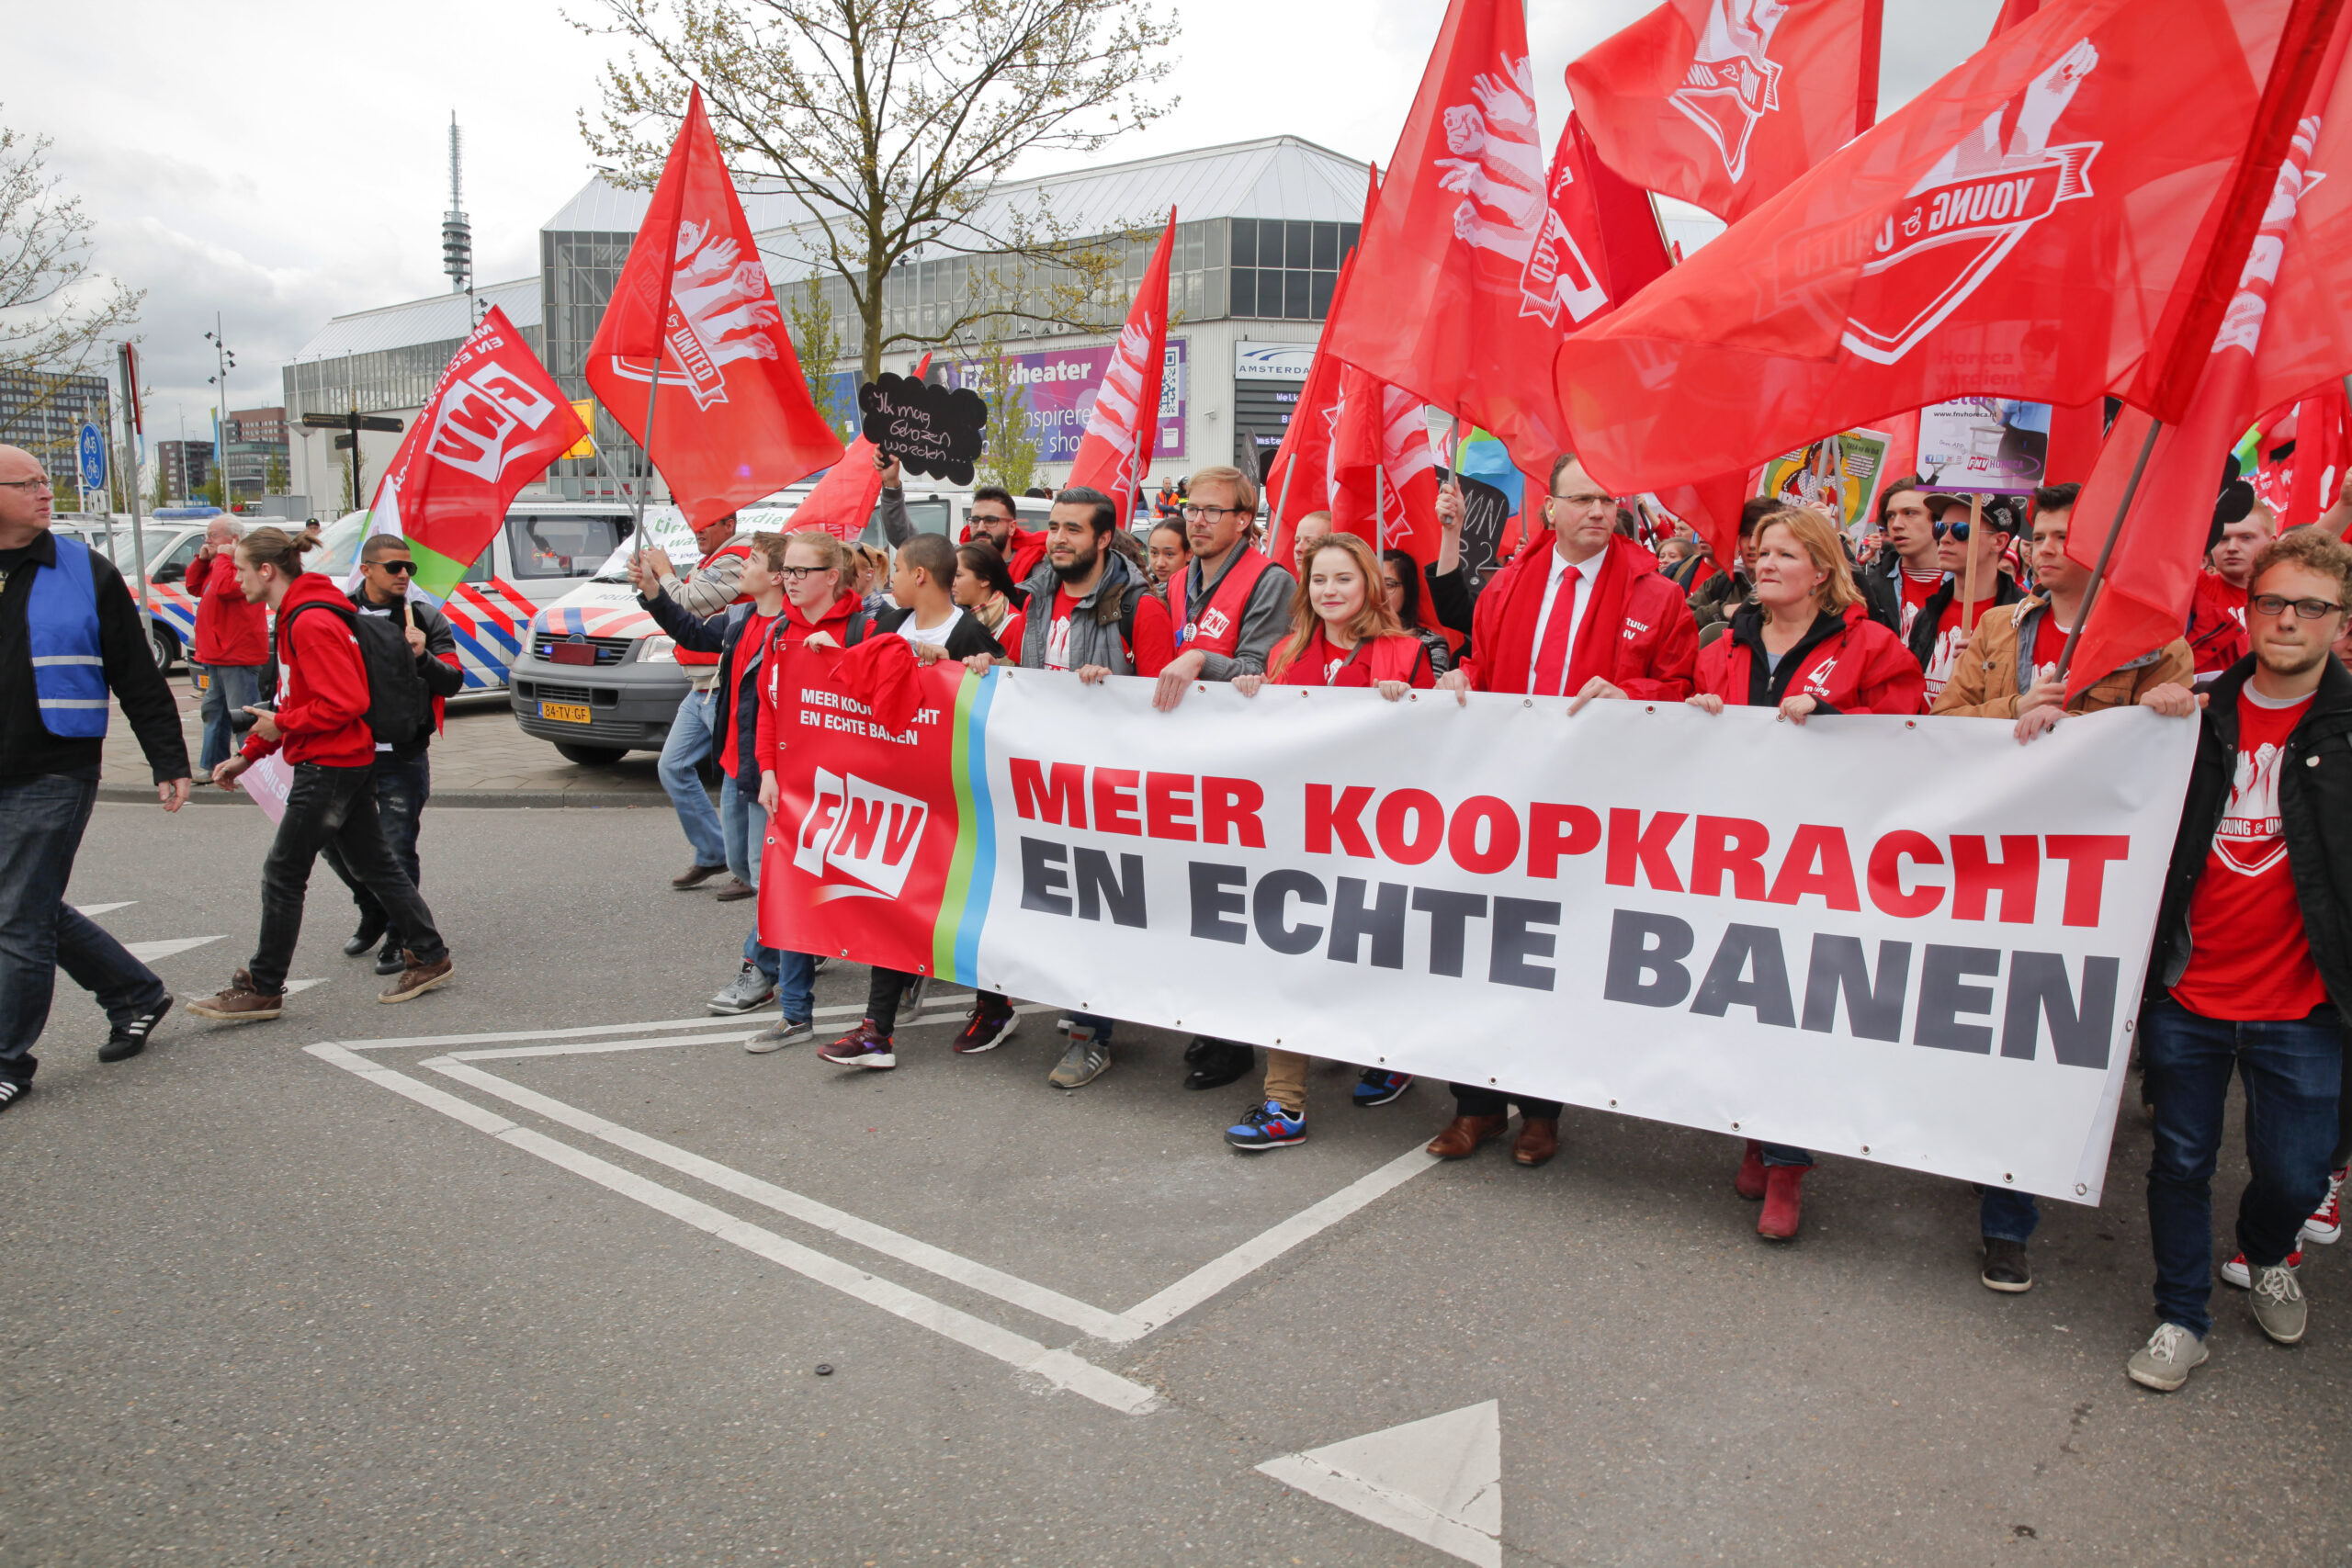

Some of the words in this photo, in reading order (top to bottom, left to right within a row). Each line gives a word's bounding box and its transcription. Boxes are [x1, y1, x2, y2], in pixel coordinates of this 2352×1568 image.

[673, 327, 715, 382] UNITED
[1009, 358, 1092, 385] theater
[1238, 365, 1310, 375] AMSTERDA
[1276, 392, 1299, 402] Welk
[897, 405, 931, 430] mag
[1023, 404, 1092, 432] nspirere
[1968, 457, 1989, 470] FNV
[1201, 612, 1229, 635] FNV
[1625, 617, 1649, 633] tuur
[801, 688, 839, 709] MEER
[545, 705, 586, 721] 84-TV-GF
[799, 710, 820, 727] EN
[824, 714, 866, 736] ECHTE
[798, 784, 926, 875] FNV
[1009, 756, 1267, 850] MEER
[1304, 783, 2131, 928] KOOPKRACHT
[1020, 835, 1148, 930] EN
[1188, 861, 1562, 992] ECHTE
[1603, 908, 2120, 1070] BANEN
